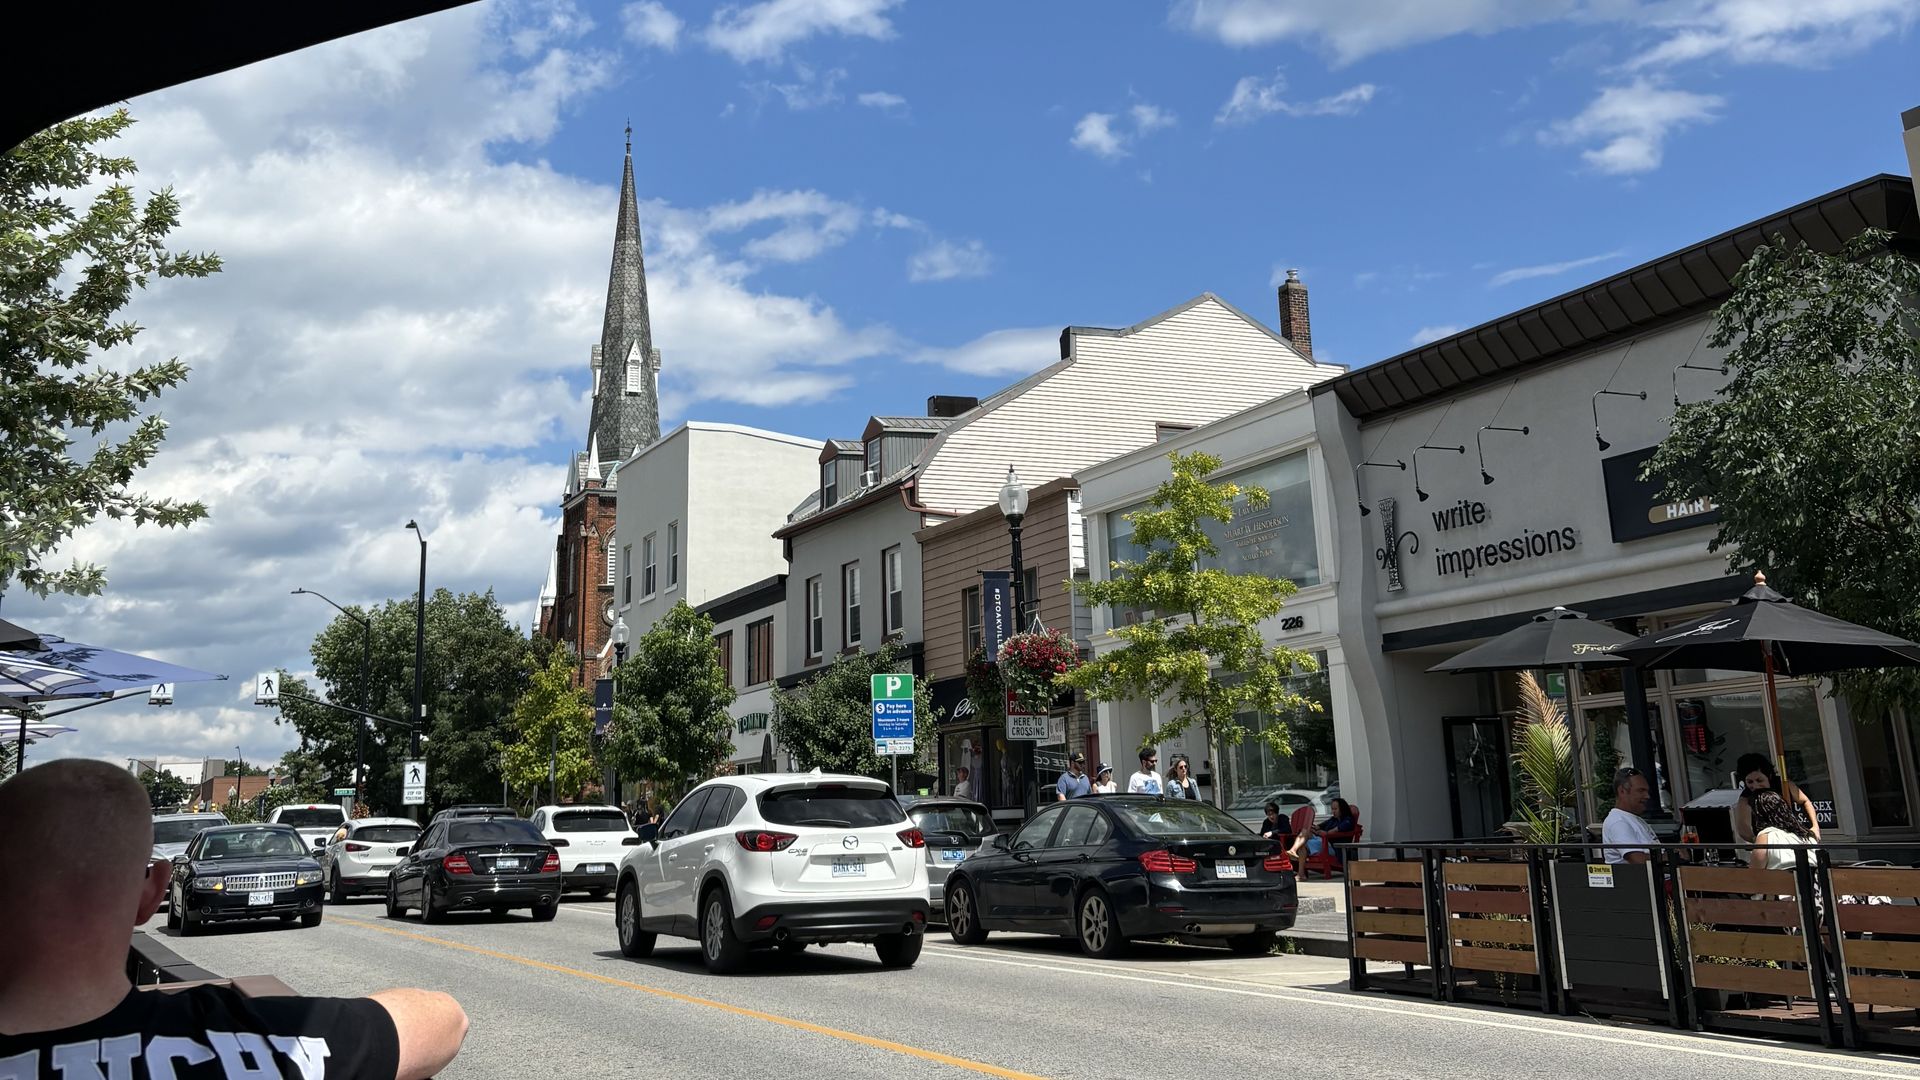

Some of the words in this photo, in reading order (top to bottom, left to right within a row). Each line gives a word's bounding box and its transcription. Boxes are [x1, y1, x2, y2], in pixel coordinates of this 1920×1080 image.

[1432, 499, 1486, 532] write
[1435, 526, 1577, 578] impressions
[1281, 615, 1304, 631] 226
[886, 676, 902, 697] P
[1013, 717, 1030, 726] HERE
[1034, 717, 1043, 726] TO
[1012, 727, 1045, 736] CROSSING
